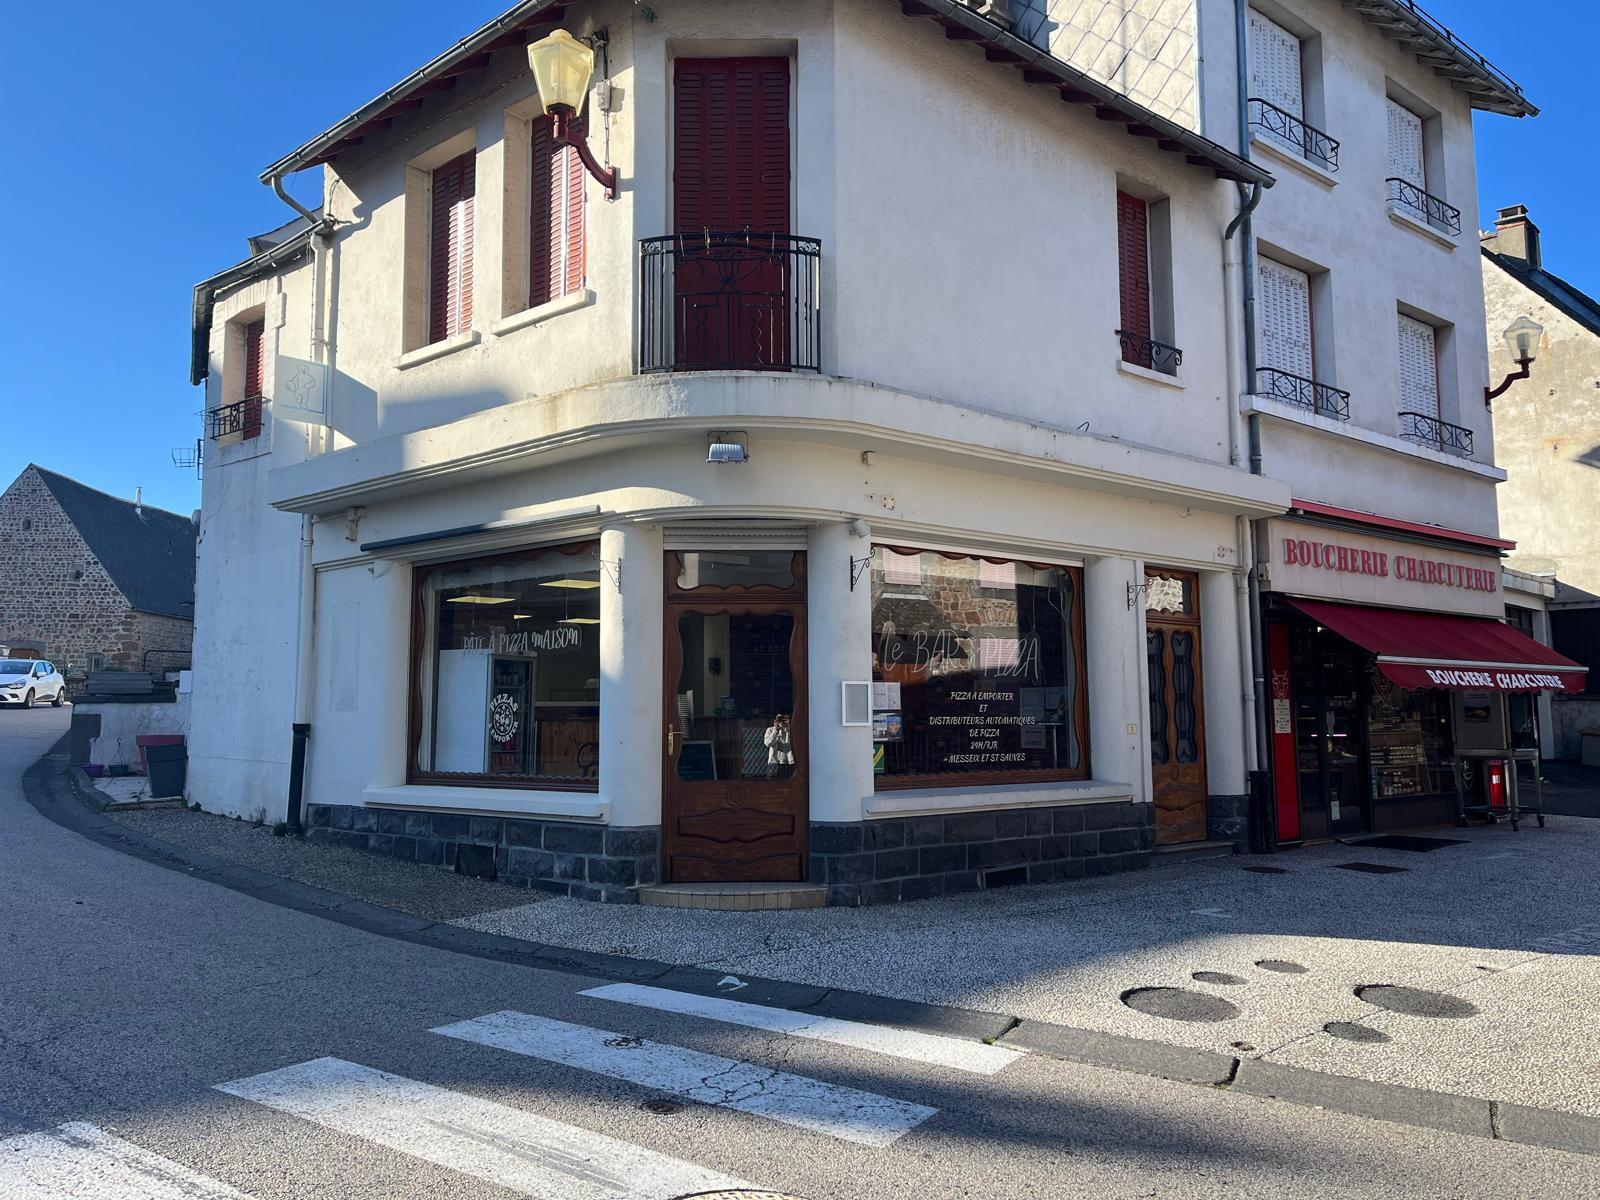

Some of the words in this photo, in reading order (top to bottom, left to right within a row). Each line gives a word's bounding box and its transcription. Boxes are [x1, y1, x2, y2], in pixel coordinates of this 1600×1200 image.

[1283, 538, 1388, 577] BOUCHERIE
[1394, 555, 1497, 593] CHARCUTERIE
[499, 631, 528, 653] PIZZA
[912, 629, 960, 675] BAR
[981, 632, 1039, 680] PIZZA
[1426, 669, 1495, 687] BOUCHERIE
[1496, 672, 1565, 689] CHARCUTERIE
[489, 693, 519, 712] PIZZAS
[950, 691, 971, 701] PIZZA
[978, 692, 1015, 701] EMPORTER
[978, 704, 989, 713] ET
[928, 716, 985, 726] DISTRIBUTEURS
[985, 716, 1036, 726] AUTOMATIQUES
[969, 728, 980, 737] DE
[980, 728, 1000, 738] PIZZA
[948, 754, 980, 763] MESSEIX
[980, 753, 990, 762] ET
[990, 753, 999, 762] ST
[999, 752, 1026, 762] SAUVES
